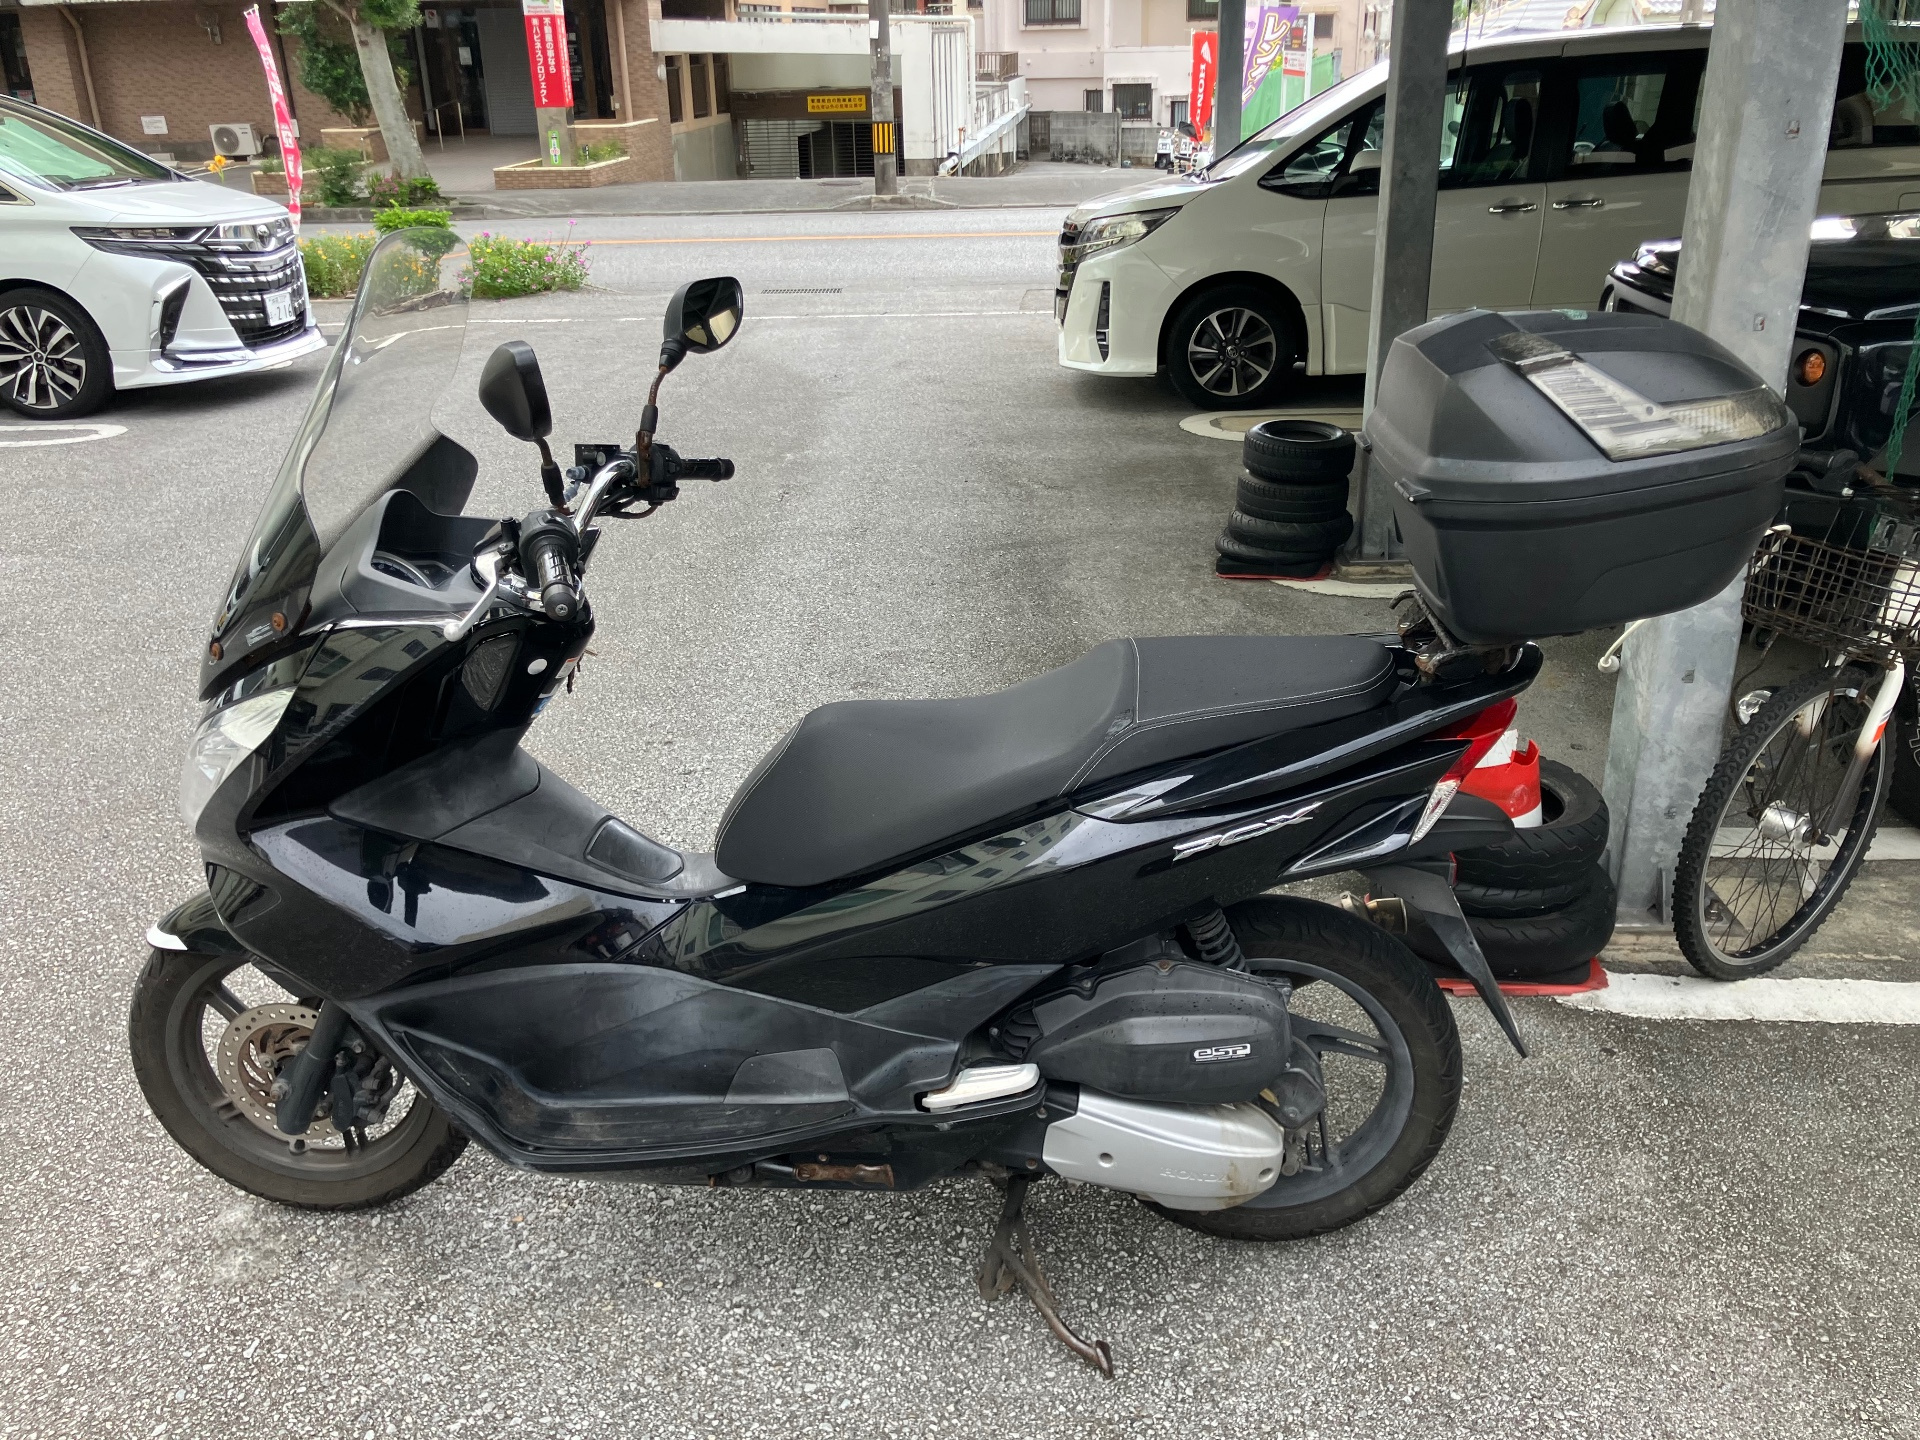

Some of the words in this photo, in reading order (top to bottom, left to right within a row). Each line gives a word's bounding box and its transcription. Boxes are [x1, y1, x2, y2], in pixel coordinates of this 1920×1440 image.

[542, 17, 556, 74] 不動産の事なら
